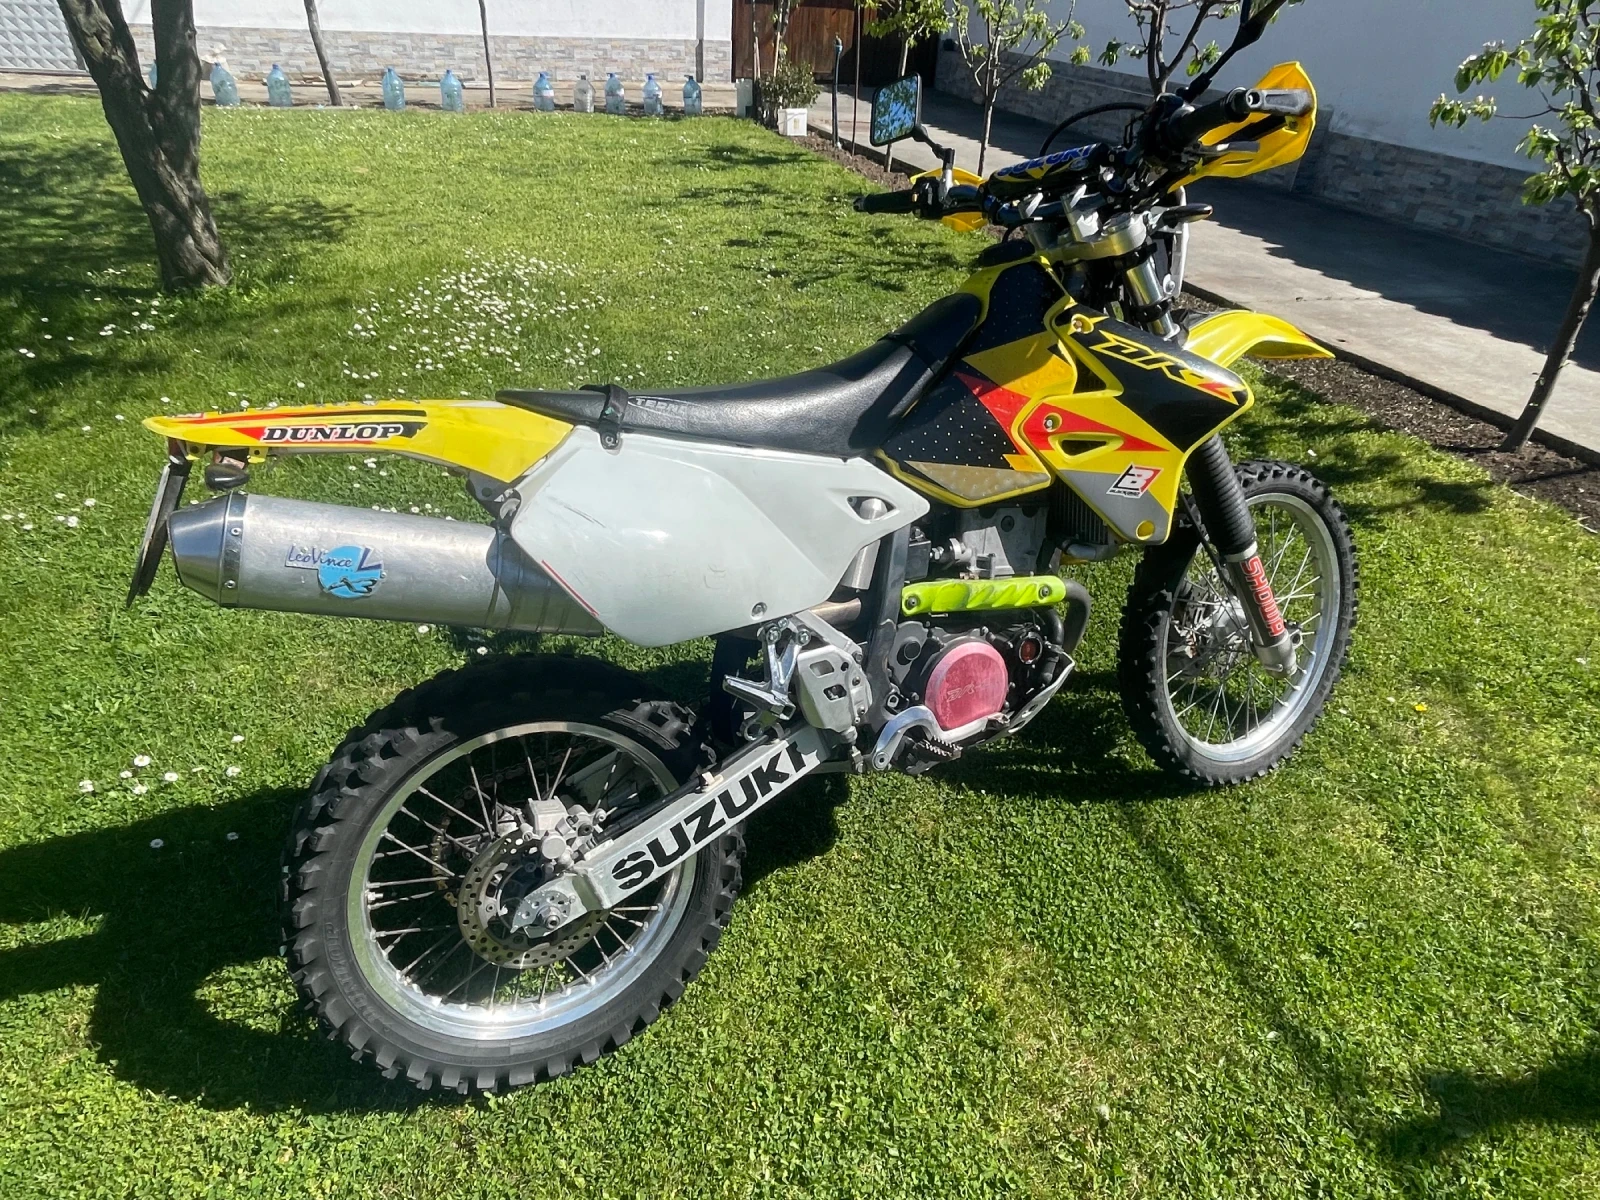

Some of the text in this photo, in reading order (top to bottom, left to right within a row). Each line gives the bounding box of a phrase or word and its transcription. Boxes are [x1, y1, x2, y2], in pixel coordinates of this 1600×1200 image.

[262, 423, 402, 442] DUNLOP
[288, 545, 353, 568] LeoVince
[1240, 555, 1287, 638] SHOWA
[611, 740, 807, 891] SUZUKI
